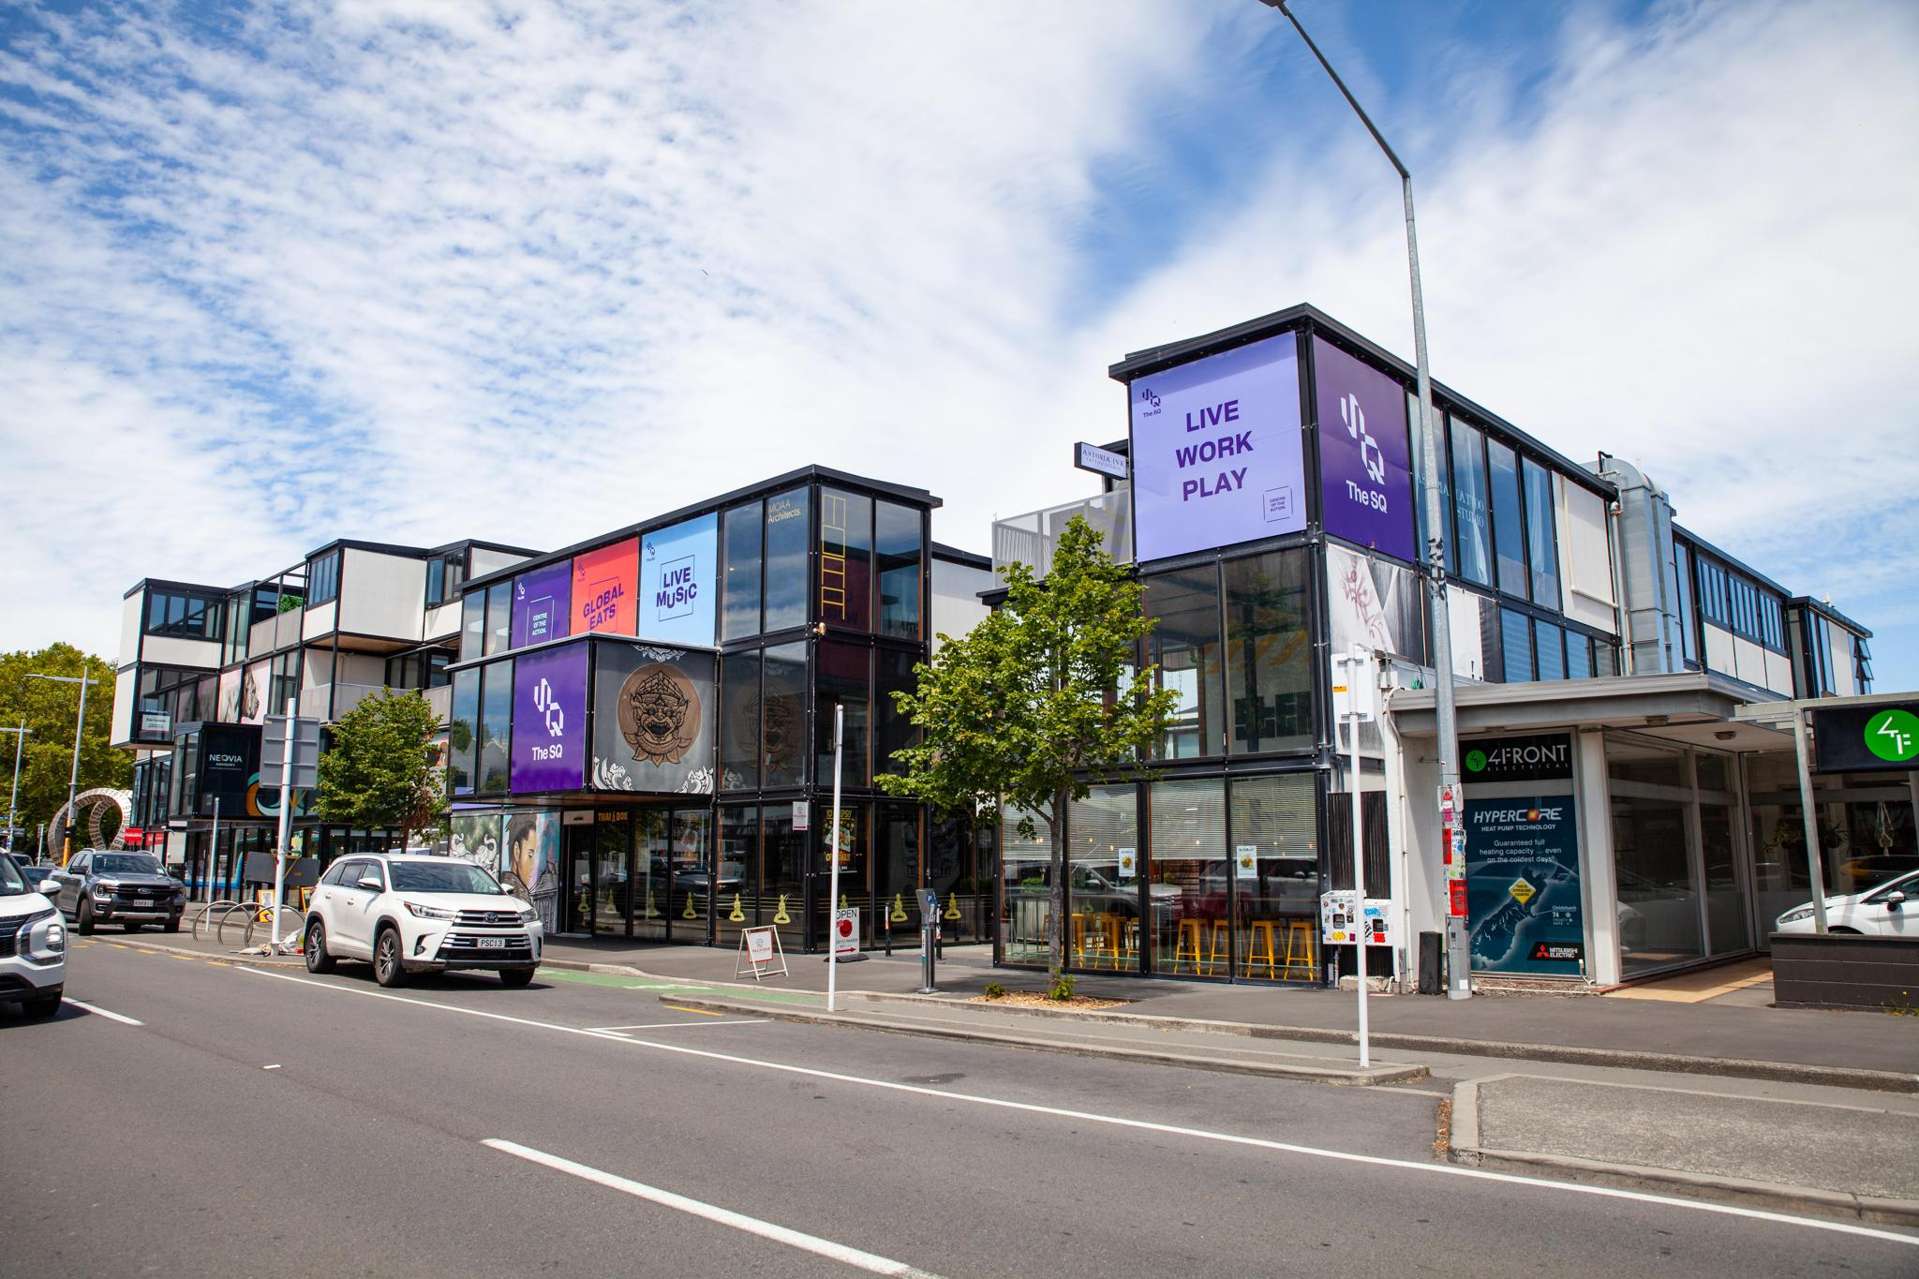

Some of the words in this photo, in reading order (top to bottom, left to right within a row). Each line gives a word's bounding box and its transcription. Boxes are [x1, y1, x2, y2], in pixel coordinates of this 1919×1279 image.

[1186, 399, 1239, 433] LIVE
[1175, 430, 1254, 469] WORK
[1182, 467, 1248, 502] PLAY
[1345, 480, 1369, 505] The
[1371, 490, 1388, 514] SQ
[663, 566, 691, 589] LIVE
[582, 583, 625, 618] GLOBAL
[656, 582, 698, 609] MUSIC
[588, 603, 616, 631] EATS
[209, 753, 243, 763] NEOVIA
[531, 746, 549, 761] The
[549, 744, 563, 759] SQ
[1488, 744, 1567, 765] 4FRONT
[1515, 823, 1556, 831] TECHNOLOGY
[1494, 839, 1533, 847] Guaranteed
[1505, 848, 1534, 856] capacity
[836, 909, 858, 919] OPEN
